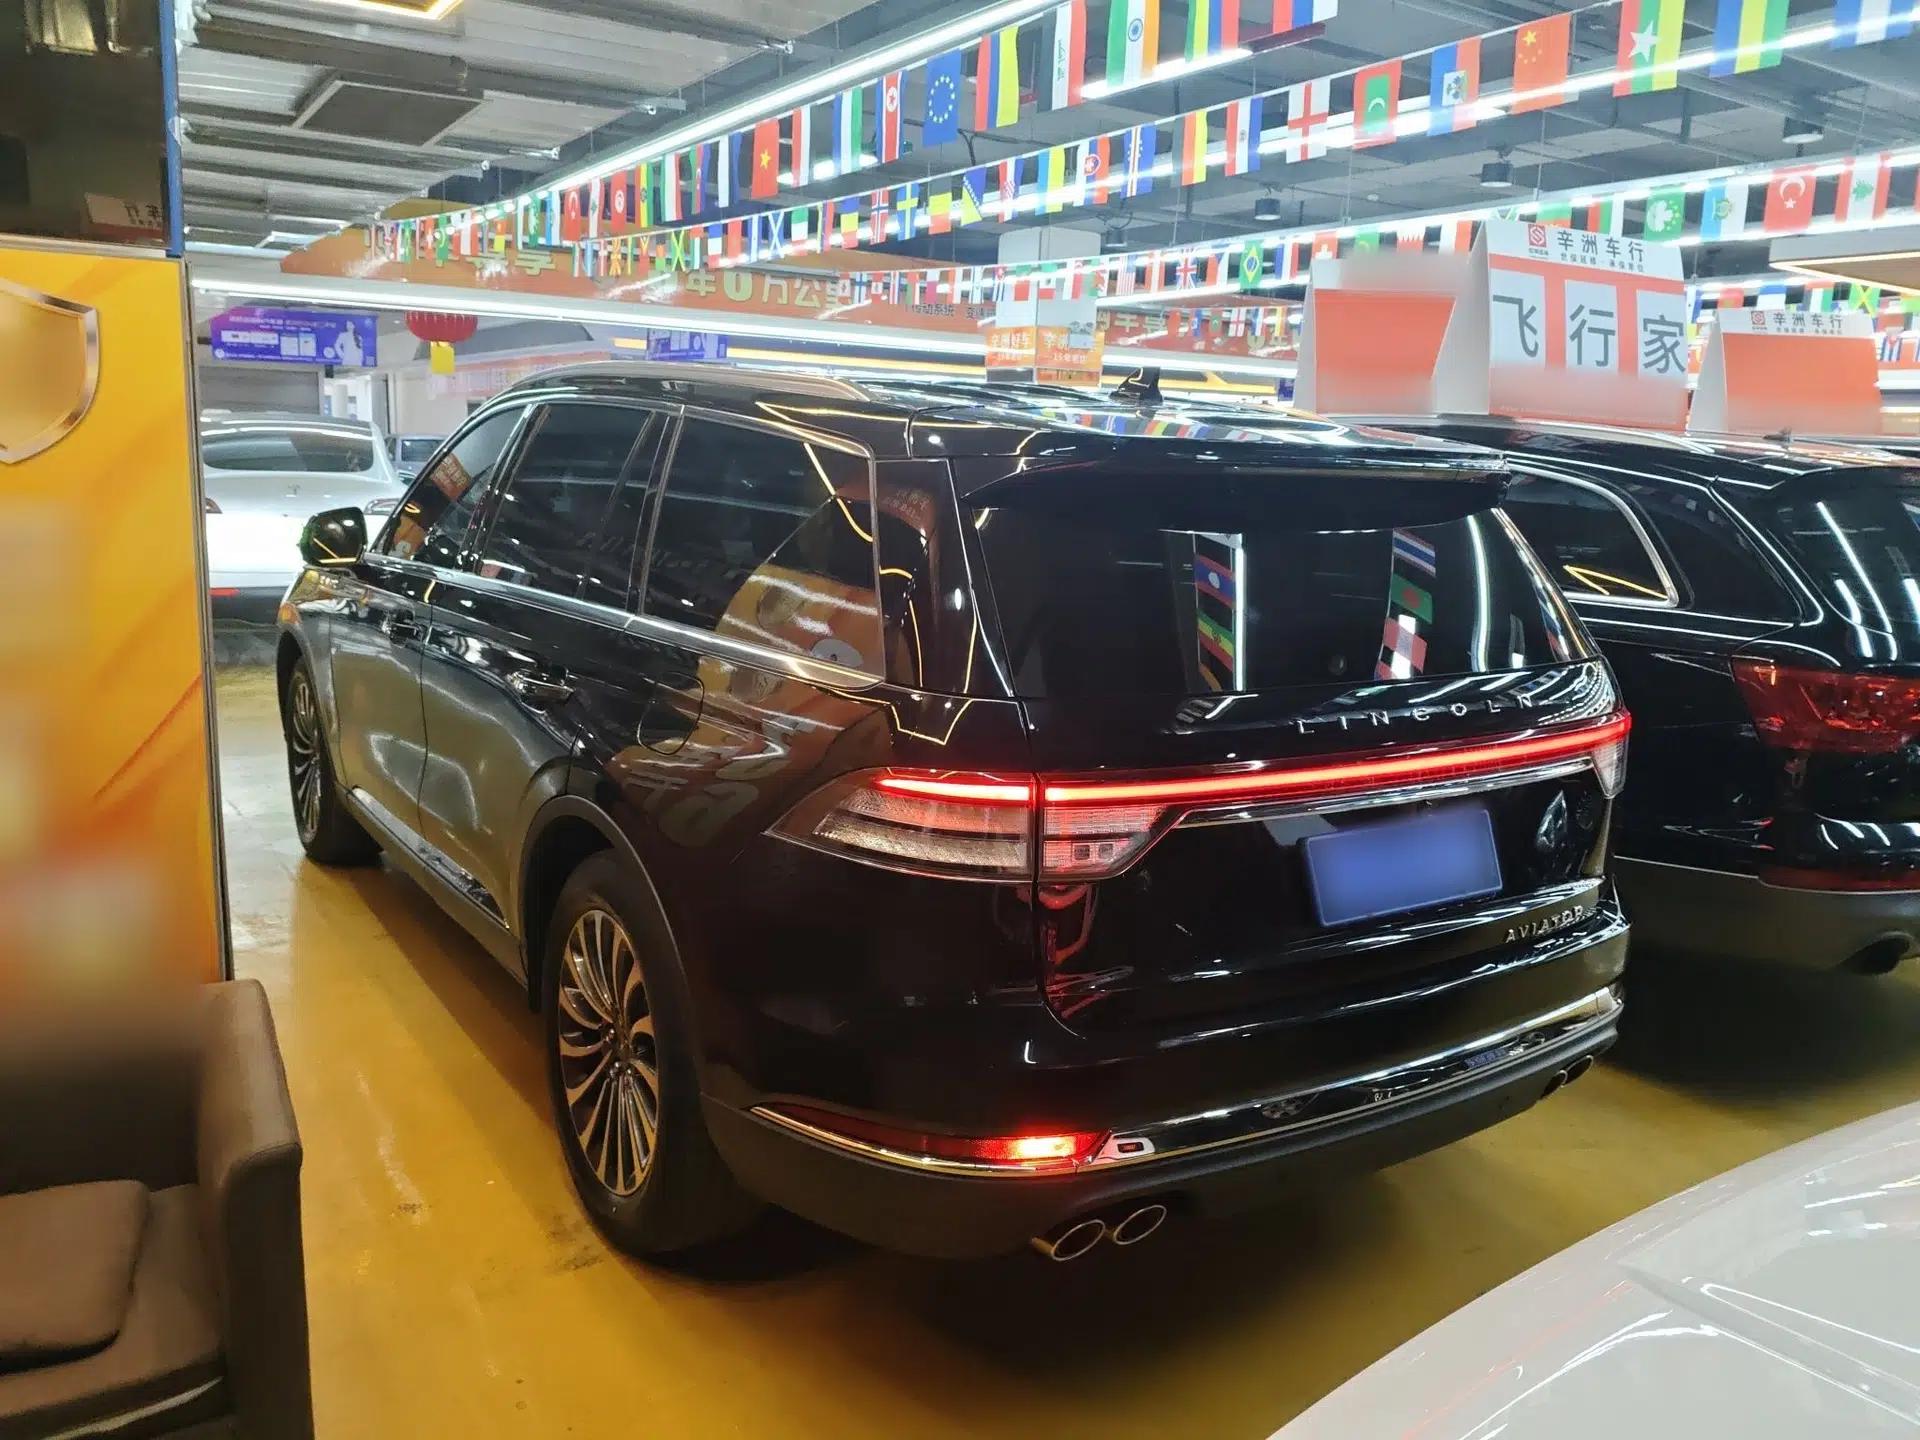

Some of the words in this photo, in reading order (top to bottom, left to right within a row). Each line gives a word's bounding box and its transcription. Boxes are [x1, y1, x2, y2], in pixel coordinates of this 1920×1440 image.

[1557, 229, 1644, 263] 辛洲车行
[1492, 294, 1686, 374] 飞行家
[1773, 312, 1843, 329] 辛洲车行
[1297, 693, 1534, 734] LINCOLN
[1505, 904, 1584, 943] AVIATOR
